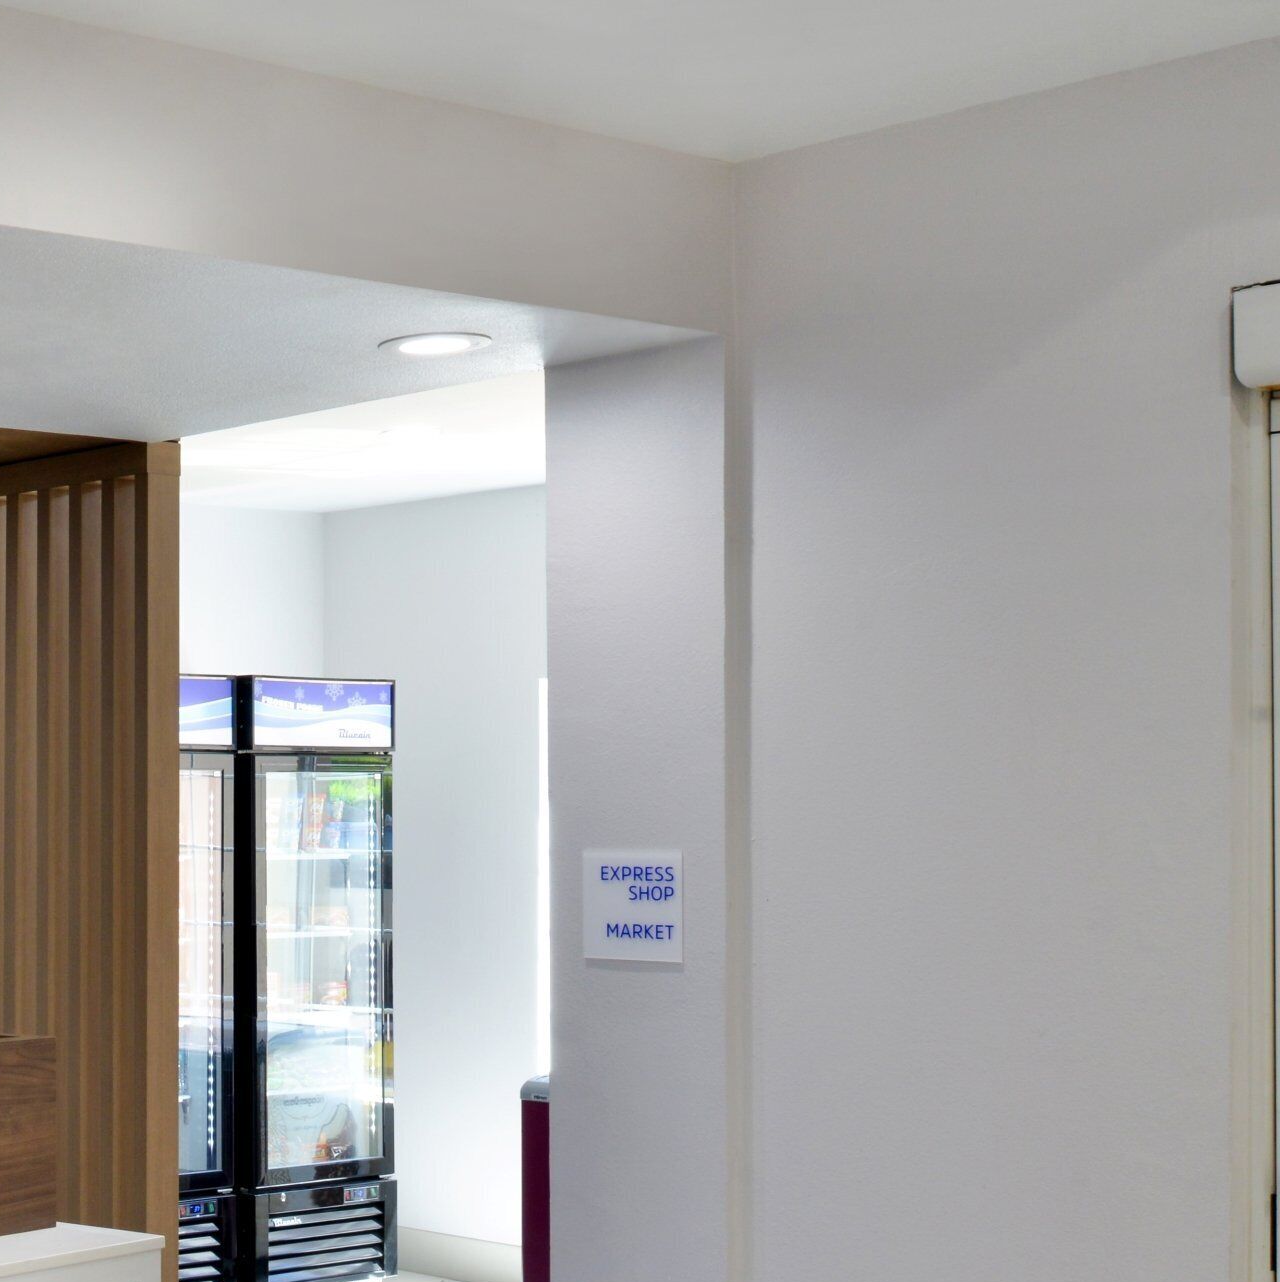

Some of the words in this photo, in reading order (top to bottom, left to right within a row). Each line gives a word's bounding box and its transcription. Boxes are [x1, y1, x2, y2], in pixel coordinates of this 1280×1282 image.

[600, 866, 674, 881] EXPRESS
[629, 885, 674, 901] SHOP
[606, 923, 674, 940] MARKET
